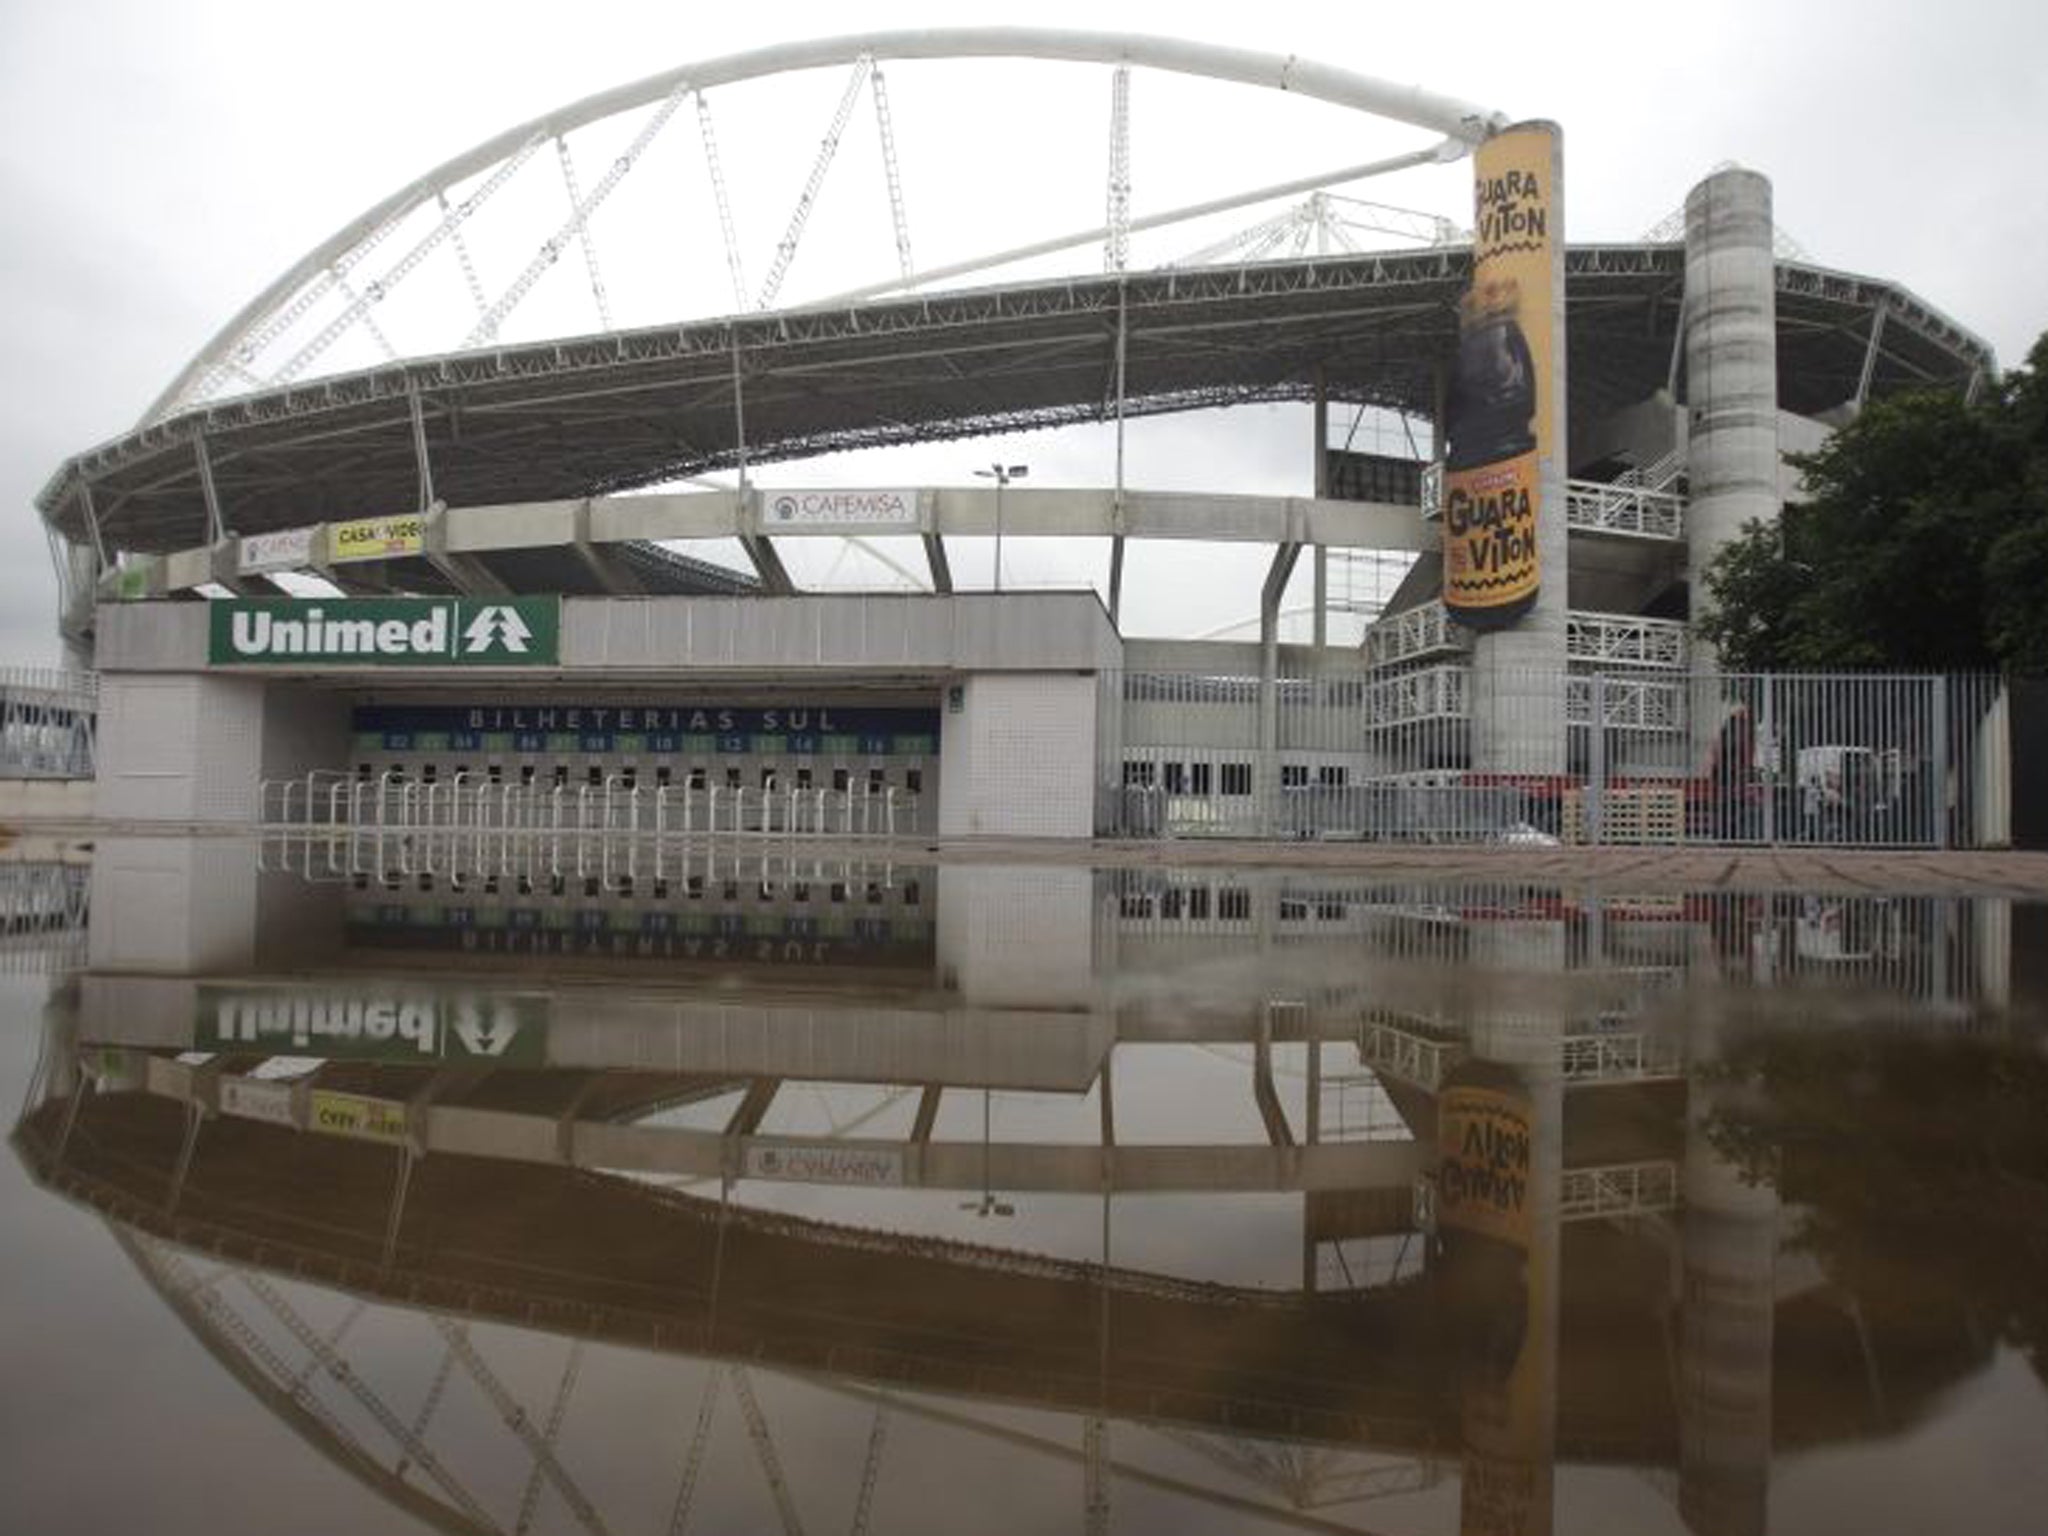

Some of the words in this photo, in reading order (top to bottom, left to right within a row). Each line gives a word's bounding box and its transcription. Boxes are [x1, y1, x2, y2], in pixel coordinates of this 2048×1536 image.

[1449, 487, 1532, 537] GUARA
[232, 607, 447, 654] Unimed
[470, 708, 735, 730] BILHETERIAS
[763, 709, 834, 731] SUL
